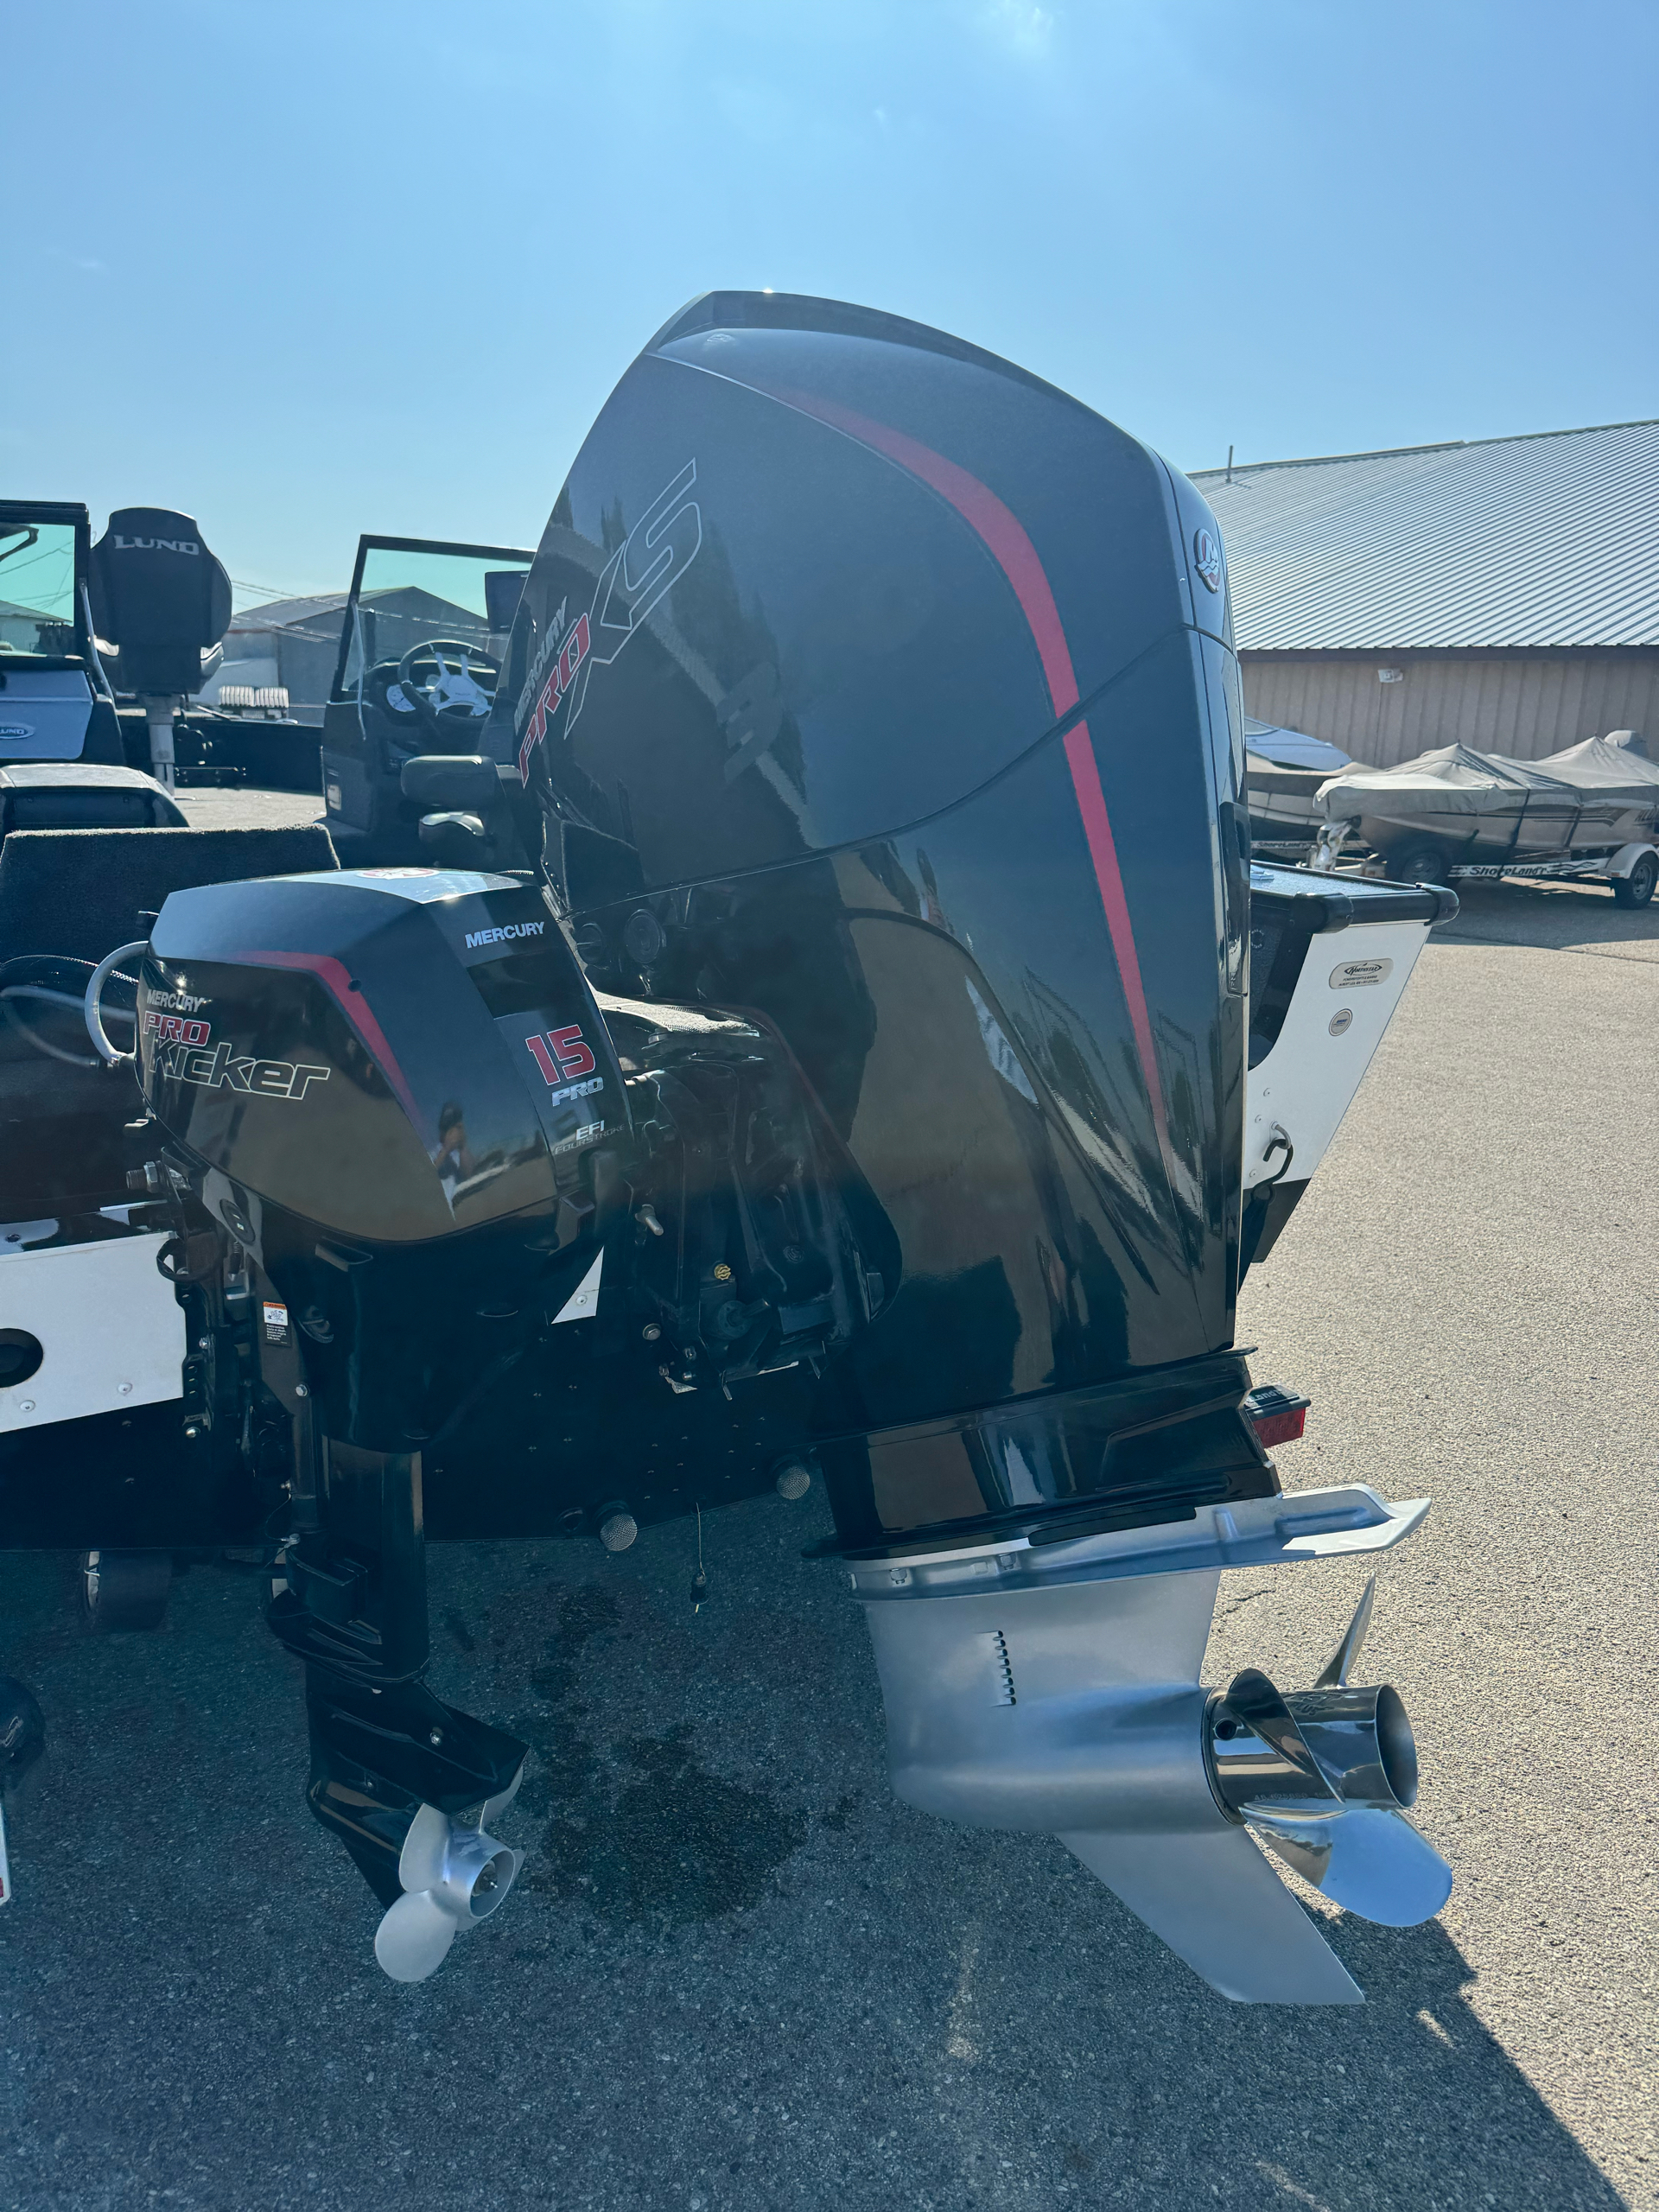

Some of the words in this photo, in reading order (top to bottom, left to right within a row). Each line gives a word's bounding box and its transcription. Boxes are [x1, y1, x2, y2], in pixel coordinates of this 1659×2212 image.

[113, 535, 200, 556] LUND
[514, 595, 568, 736] MERCURY
[519, 612, 591, 790] PRO
[464, 921, 545, 949] MERCURY
[147, 988, 206, 1013] MERCURY
[143, 1010, 212, 1047] PRO
[525, 1024, 596, 1086] 15
[551, 1076, 605, 1107] PRO
[575, 1120, 605, 1141] EFI
